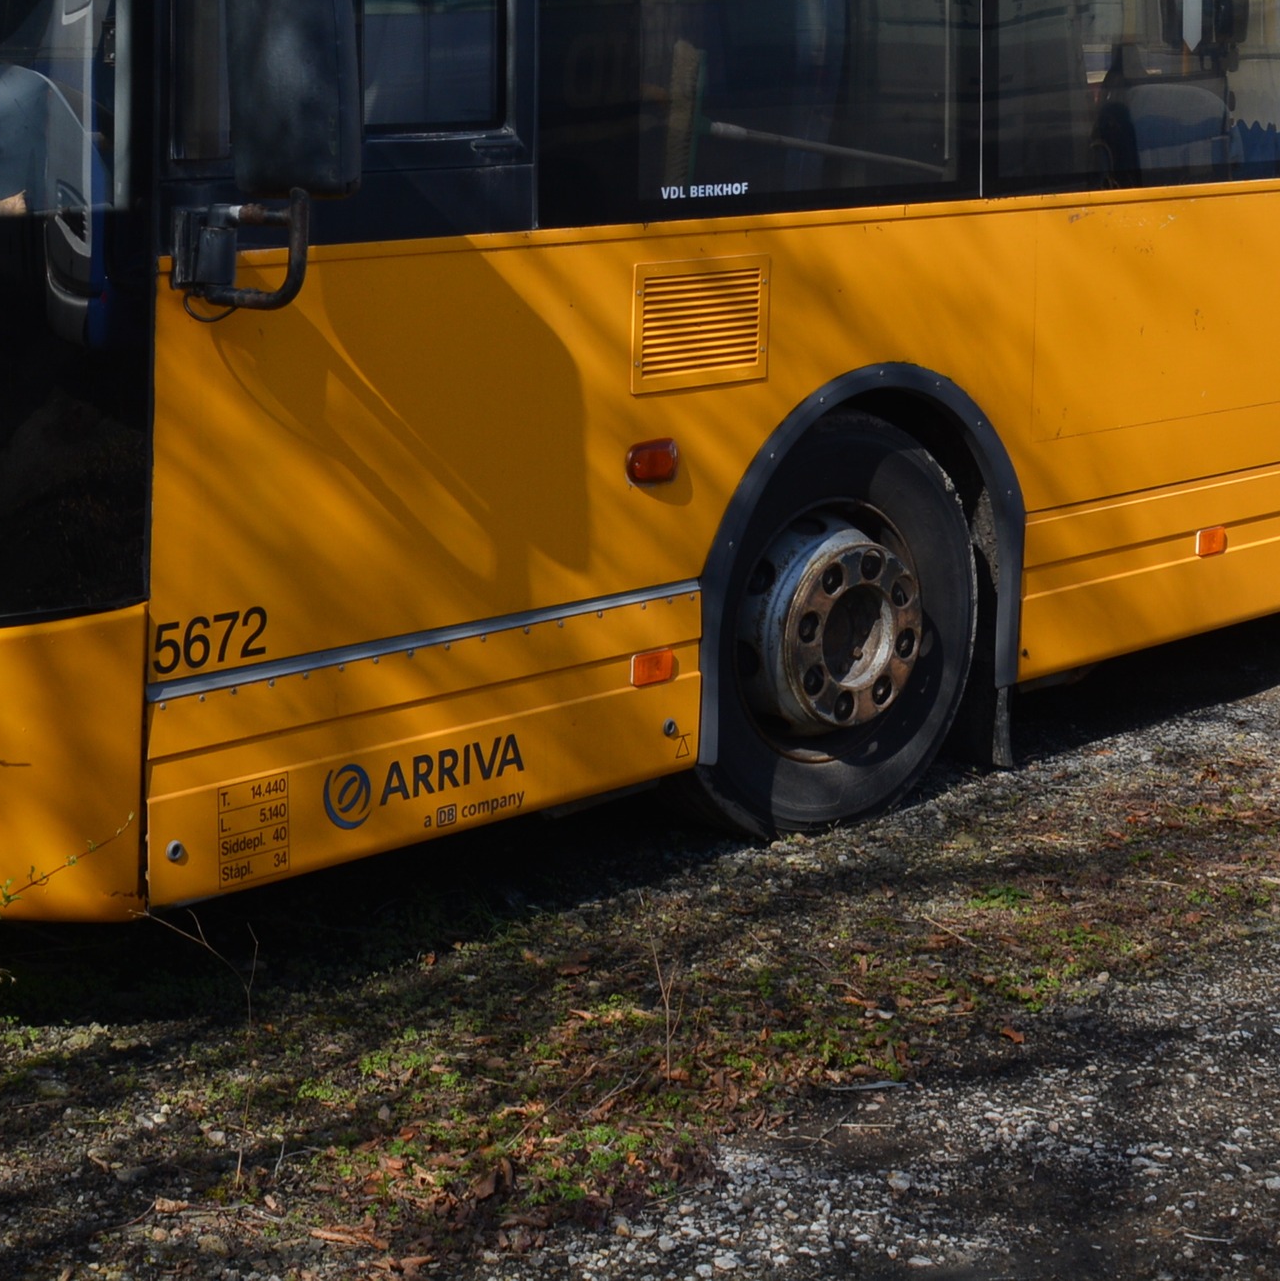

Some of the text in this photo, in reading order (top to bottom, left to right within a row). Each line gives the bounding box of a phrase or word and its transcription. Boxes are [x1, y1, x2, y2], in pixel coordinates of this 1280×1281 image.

[661, 182, 749, 199] VDL BERKHOF
[153, 606, 267, 674] 5672
[379, 733, 525, 806] ARRIVA
[221, 778, 286, 807] T. 14.440
[221, 803, 286, 833] L. 5.140
[423, 791, 525, 828] a DB company
[221, 826, 287, 856] Siddepl. 40
[222, 851, 287, 881] Ståpl. 34
